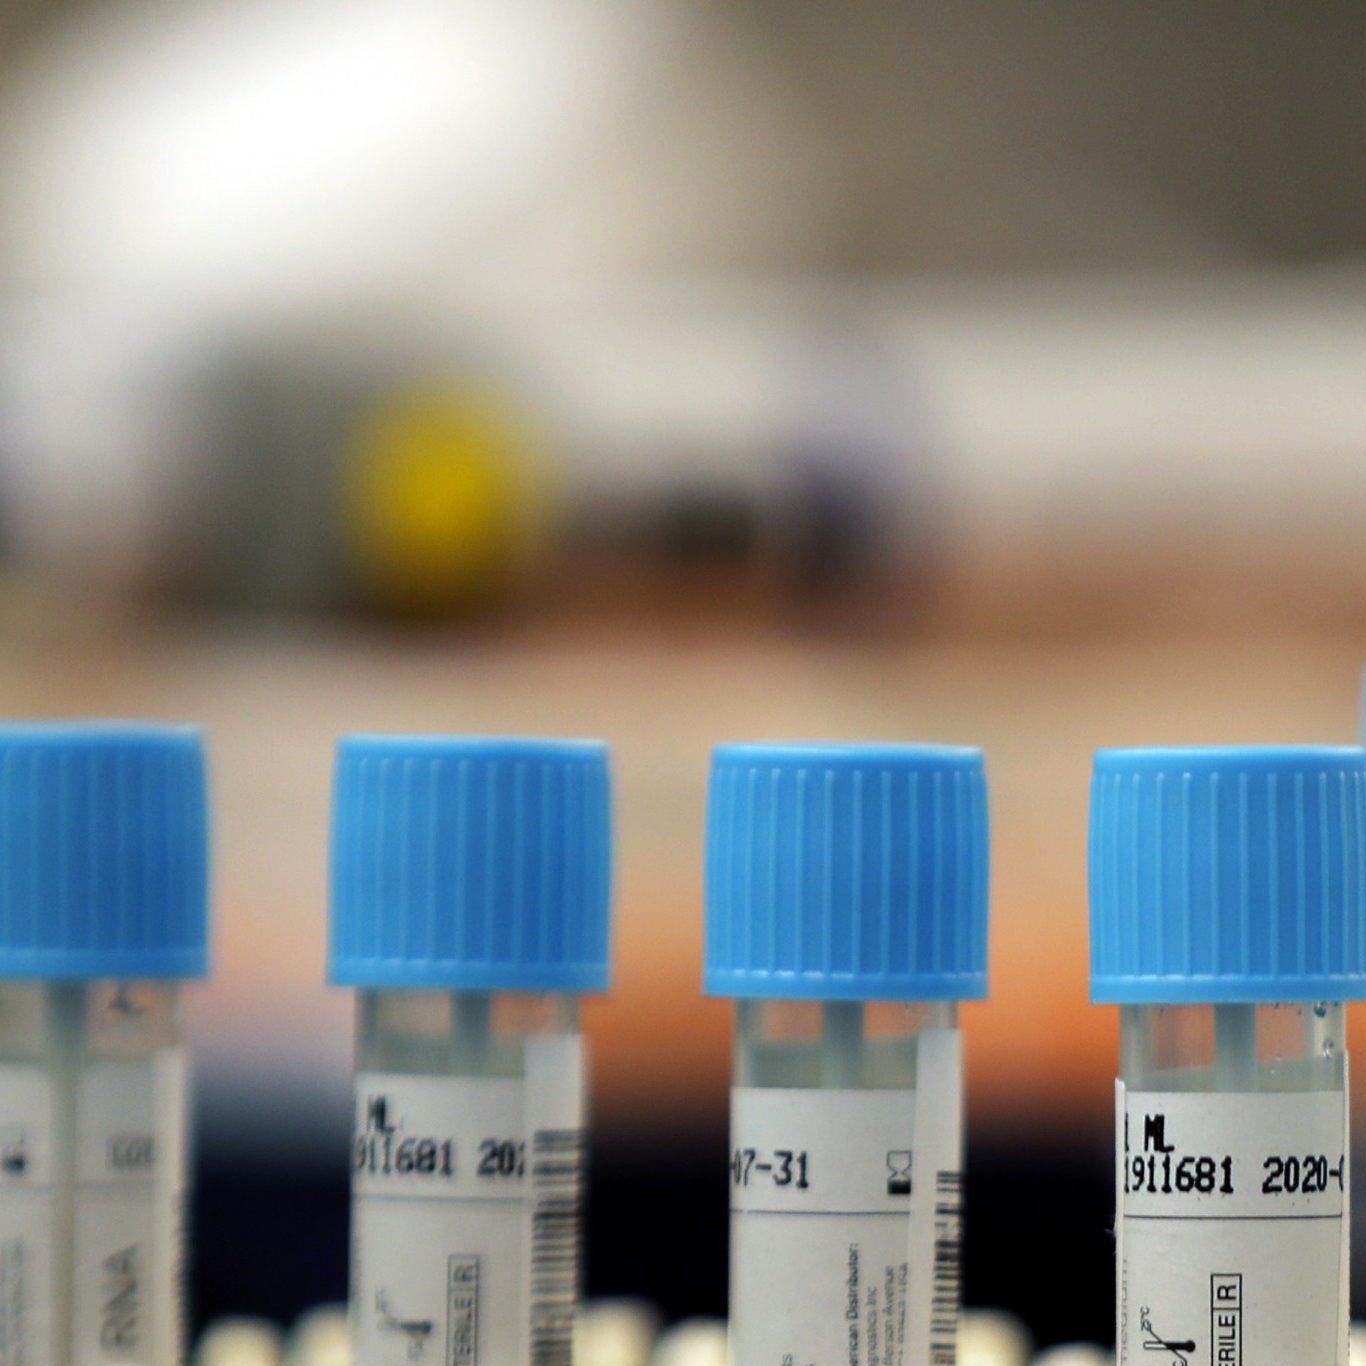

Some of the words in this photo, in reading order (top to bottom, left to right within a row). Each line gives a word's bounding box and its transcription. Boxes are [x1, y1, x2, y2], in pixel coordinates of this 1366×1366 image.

[1144, 1113, 1175, 1152] ML
[99, 1242, 140, 1351] RNA
[846, 1243, 859, 1320] Distributor:
[865, 1287, 877, 1306] Inc
[882, 1266, 894, 1316] Avenue
[1217, 1285, 1236, 1301] R
